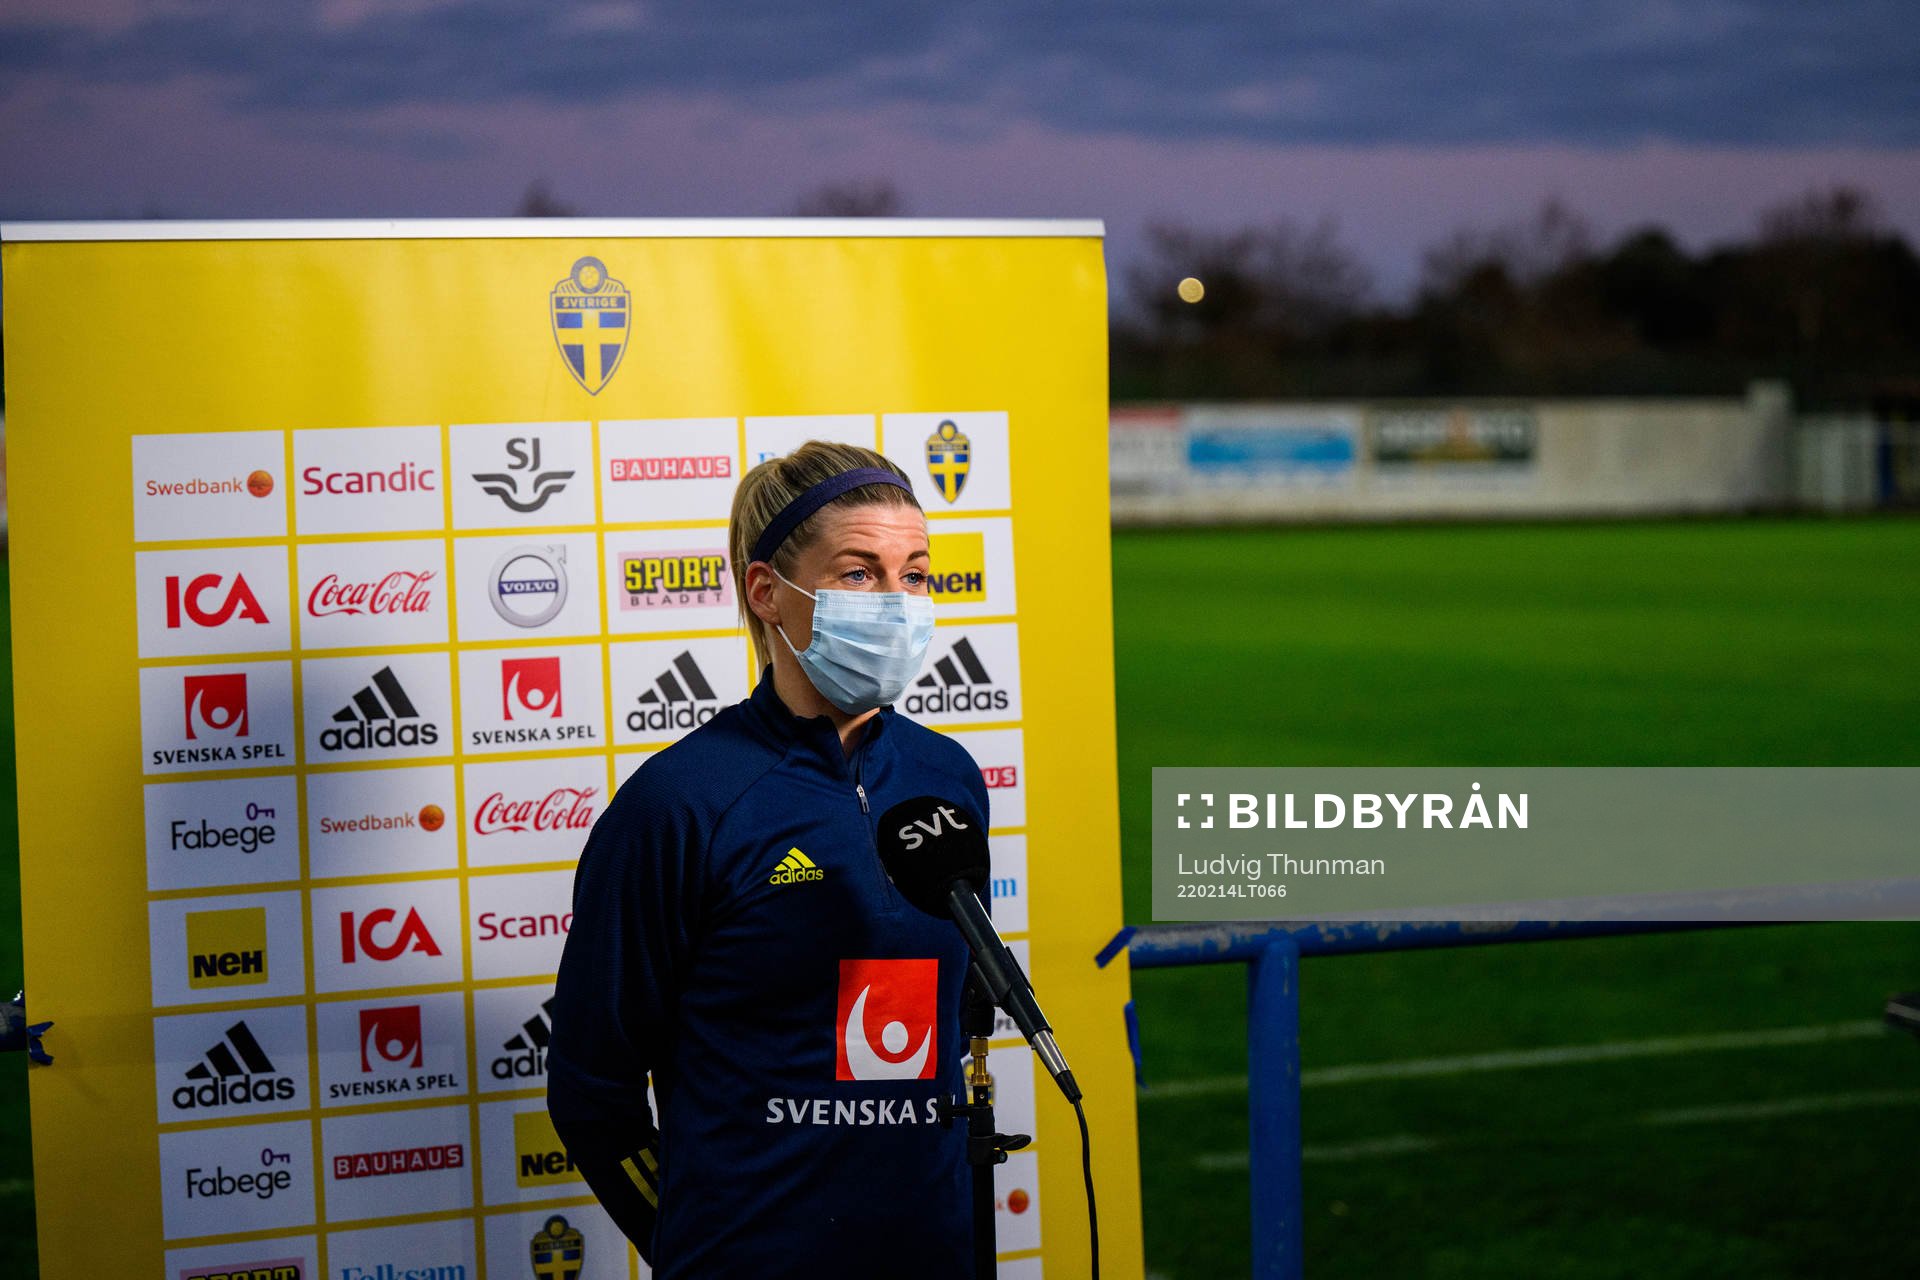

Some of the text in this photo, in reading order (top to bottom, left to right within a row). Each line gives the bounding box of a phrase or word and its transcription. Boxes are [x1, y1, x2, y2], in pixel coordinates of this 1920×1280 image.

[562, 297, 618, 307] SVERIGE
[506, 437, 541, 472] SJ
[612, 457, 730, 479] BAUHAUS
[146, 477, 243, 496] Swedbank
[303, 462, 436, 496] Scandic
[502, 581, 557, 593] VOLVO
[624, 555, 726, 593] SPORT
[165, 572, 270, 629] ICA
[307, 570, 438, 617] Coca-Cola
[630, 592, 724, 607] BLADET
[905, 685, 1009, 714] adidas
[626, 701, 722, 732] adida
[319, 718, 439, 752] adidas
[472, 725, 596, 745] SVENSKA SPEL
[153, 743, 285, 765] SVENSKA SPEL
[320, 812, 414, 833] Swedbank
[474, 786, 600, 835] Coca-Cola
[171, 819, 276, 853] Fabege
[898, 805, 969, 850] svt
[769, 867, 824, 885] adidas
[340, 906, 442, 964] ICA
[478, 912, 574, 941] Scan
[491, 1048, 551, 1079] adi
[172, 1074, 295, 1110] adidas
[329, 1074, 459, 1099] SVENSKA SPEL
[766, 1097, 918, 1126] SVENSKA
[336, 1147, 462, 1176] BAUHAUS
[186, 1166, 291, 1200] Fabege
